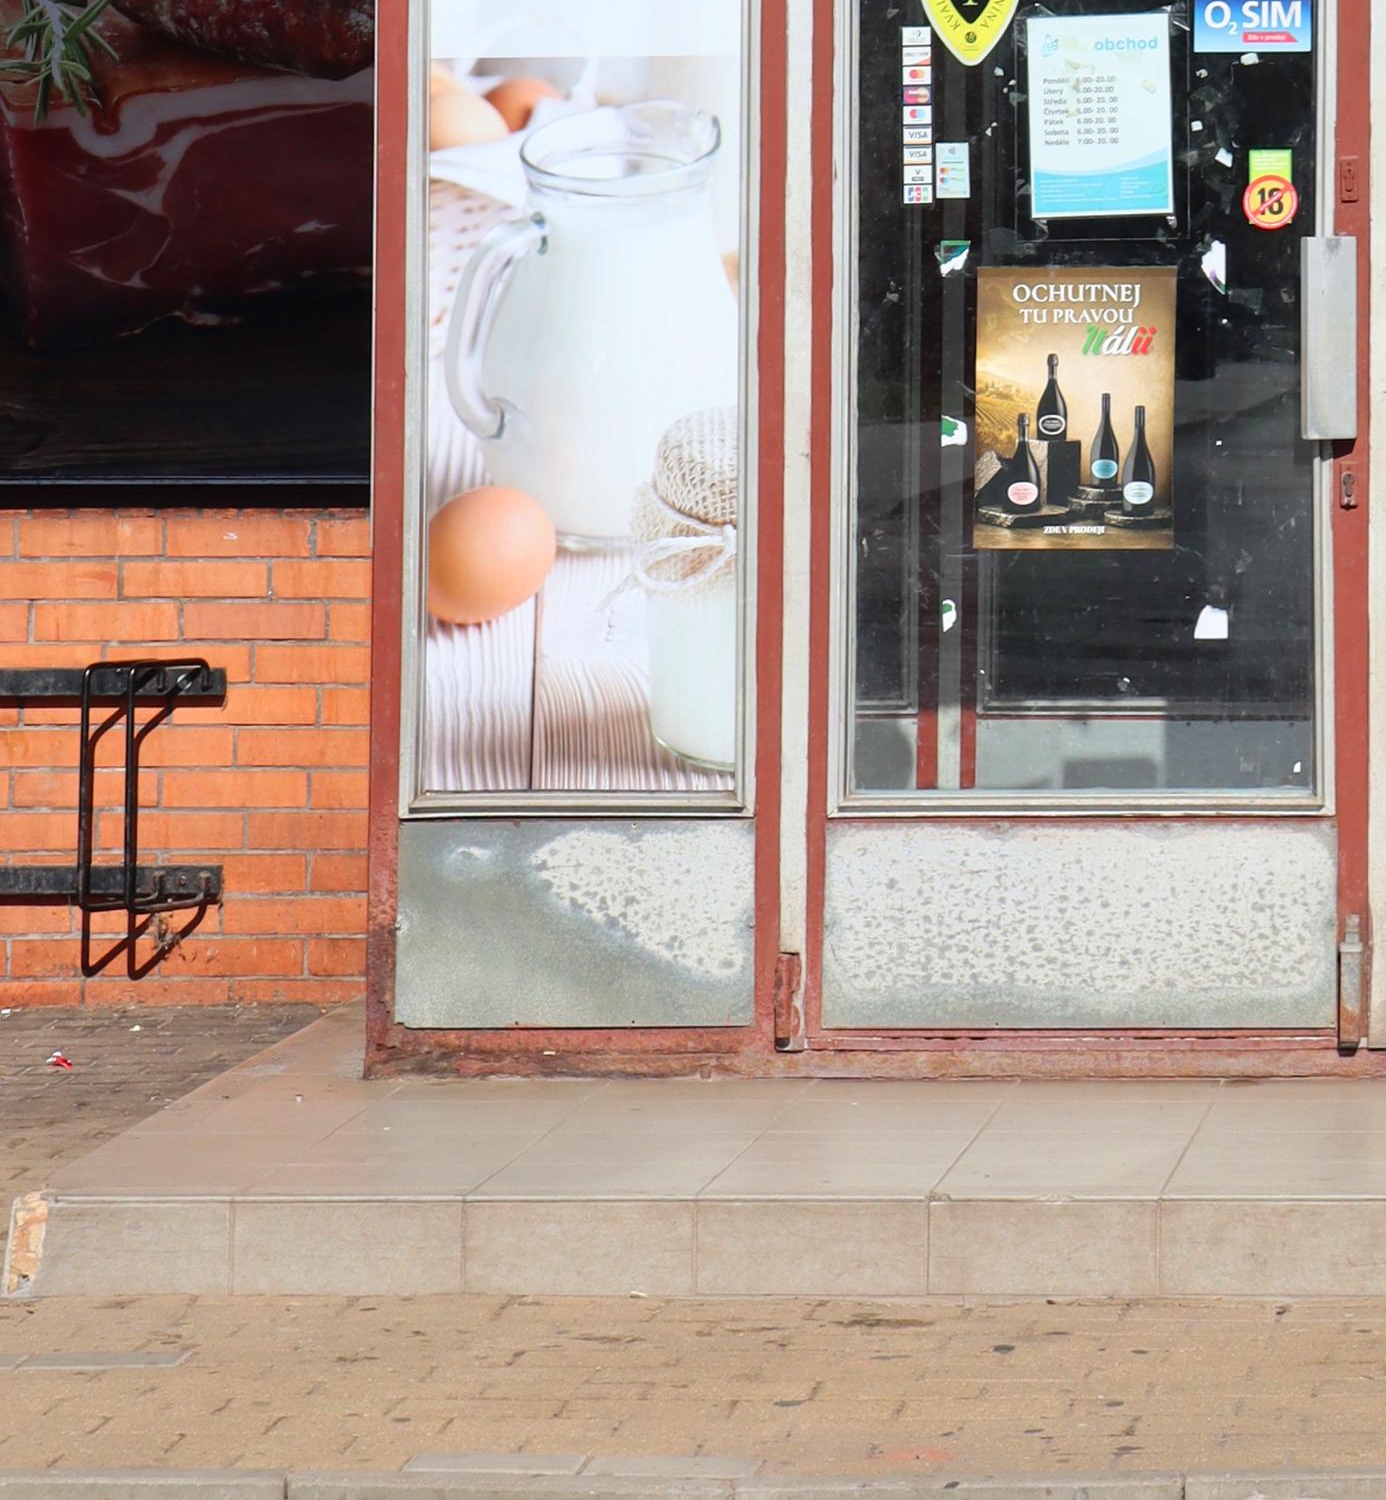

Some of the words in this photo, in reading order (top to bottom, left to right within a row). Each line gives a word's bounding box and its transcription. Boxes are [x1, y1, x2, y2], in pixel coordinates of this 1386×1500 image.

[1241, 0, 1302, 29] SIM
[1094, 36, 1158, 51] obchod
[908, 131, 928, 139] VISA
[908, 150, 928, 158] VISA
[1012, 283, 1142, 308] OCHUTNEJ
[1019, 308, 1048, 324] TU
[1052, 308, 1134, 324] PRAVOU
[1081, 324, 1158, 357] Itálii
